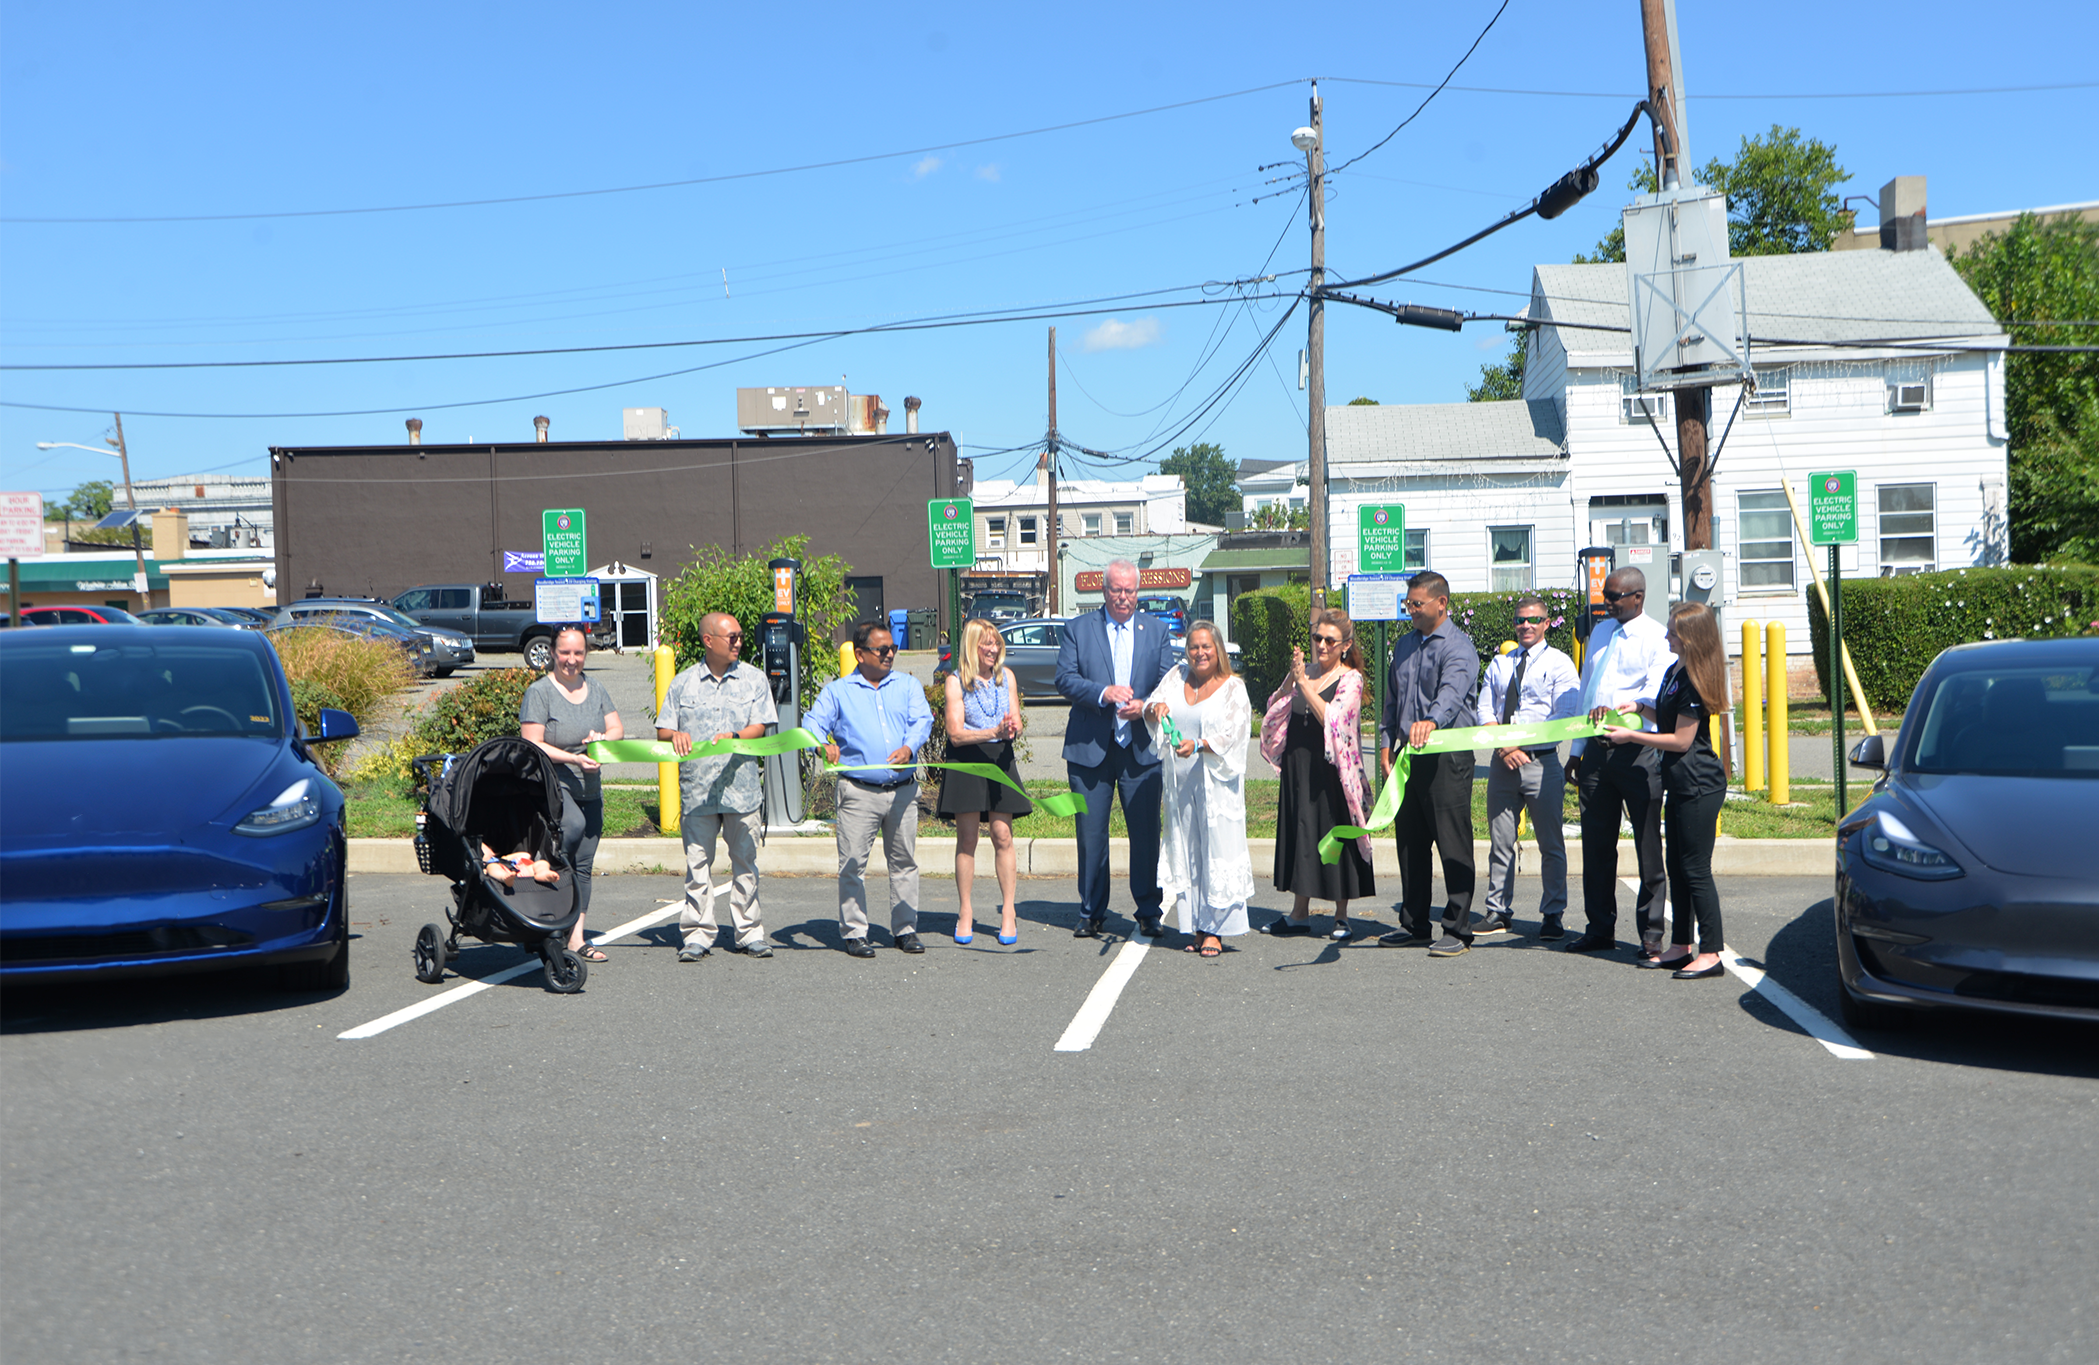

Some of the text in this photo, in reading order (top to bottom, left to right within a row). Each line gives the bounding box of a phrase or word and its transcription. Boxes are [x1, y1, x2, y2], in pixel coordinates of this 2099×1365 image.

[1814, 496, 1852, 505] ELECTRIC
[1816, 504, 1851, 514] VEHICLE
[1815, 512, 1852, 522] PARKING
[933, 522, 969, 531] ELECTRIC
[1822, 521, 1844, 530] ONLY
[935, 530, 968, 538] VEHICLE
[935, 538, 969, 546] PARKING
[1364, 536, 1398, 544] VEHICLE
[1140, 570, 1186, 584] RESSIONS
[1591, 578, 1604, 588] EV
[778, 588, 790, 597] EV
